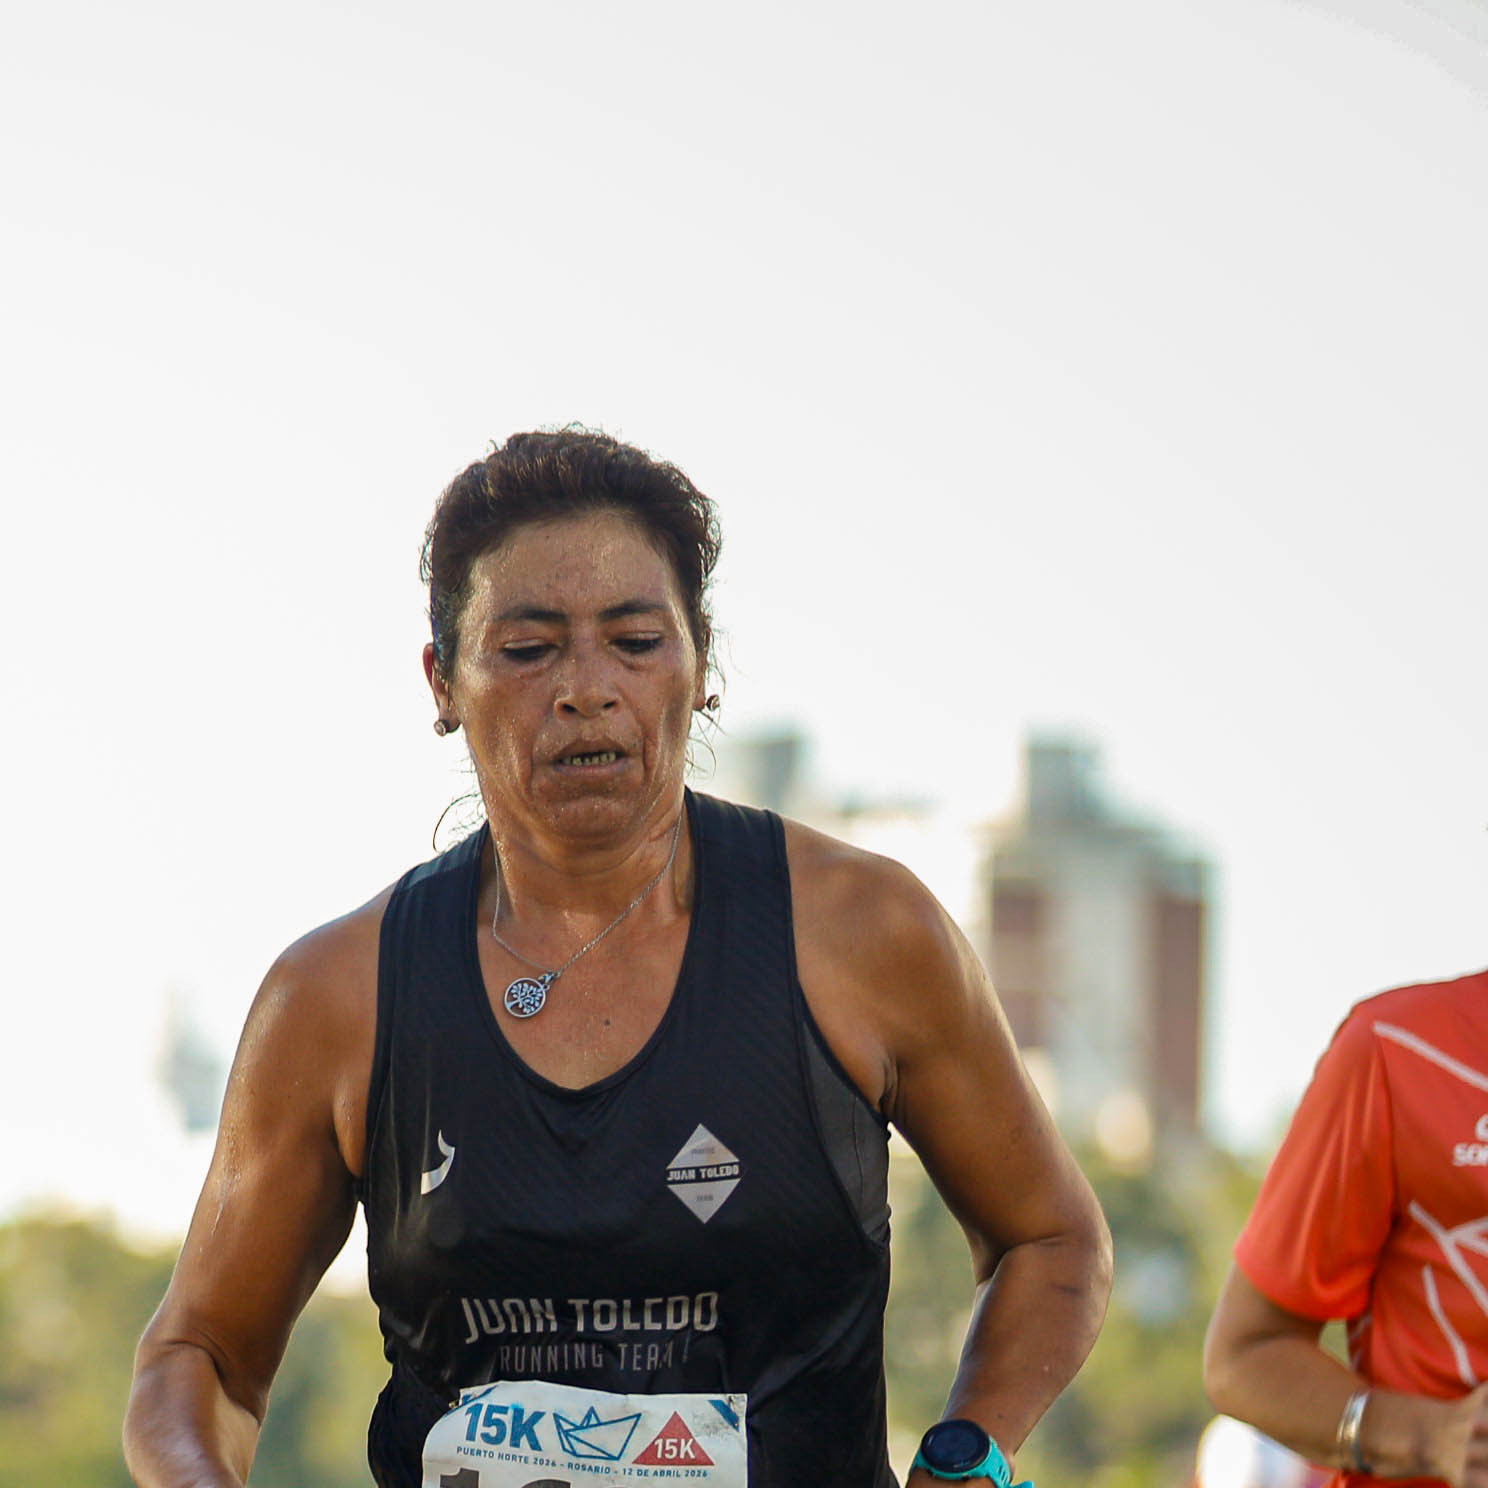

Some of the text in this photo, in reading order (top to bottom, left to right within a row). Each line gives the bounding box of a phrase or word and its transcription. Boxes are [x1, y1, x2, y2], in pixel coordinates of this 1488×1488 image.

[667, 1164, 740, 1181] JUAN TOLEDO
[461, 1291, 719, 1344] JUAN TOLEDO
[500, 1341, 674, 1373] RUNNING TEAM
[464, 1402, 547, 1452] 15K
[456, 1446, 495, 1459] PUERTO
[498, 1453, 529, 1464] NORTE
[533, 1457, 557, 1467] 2026
[567, 1462, 611, 1475] ROSARIO
[623, 1467, 633, 1476] 12
[636, 1468, 649, 1477] DE
[652, 1469, 681, 1478] ABRIL
[684, 1469, 708, 1478] 2026
[654, 1437, 697, 1459] 15K
